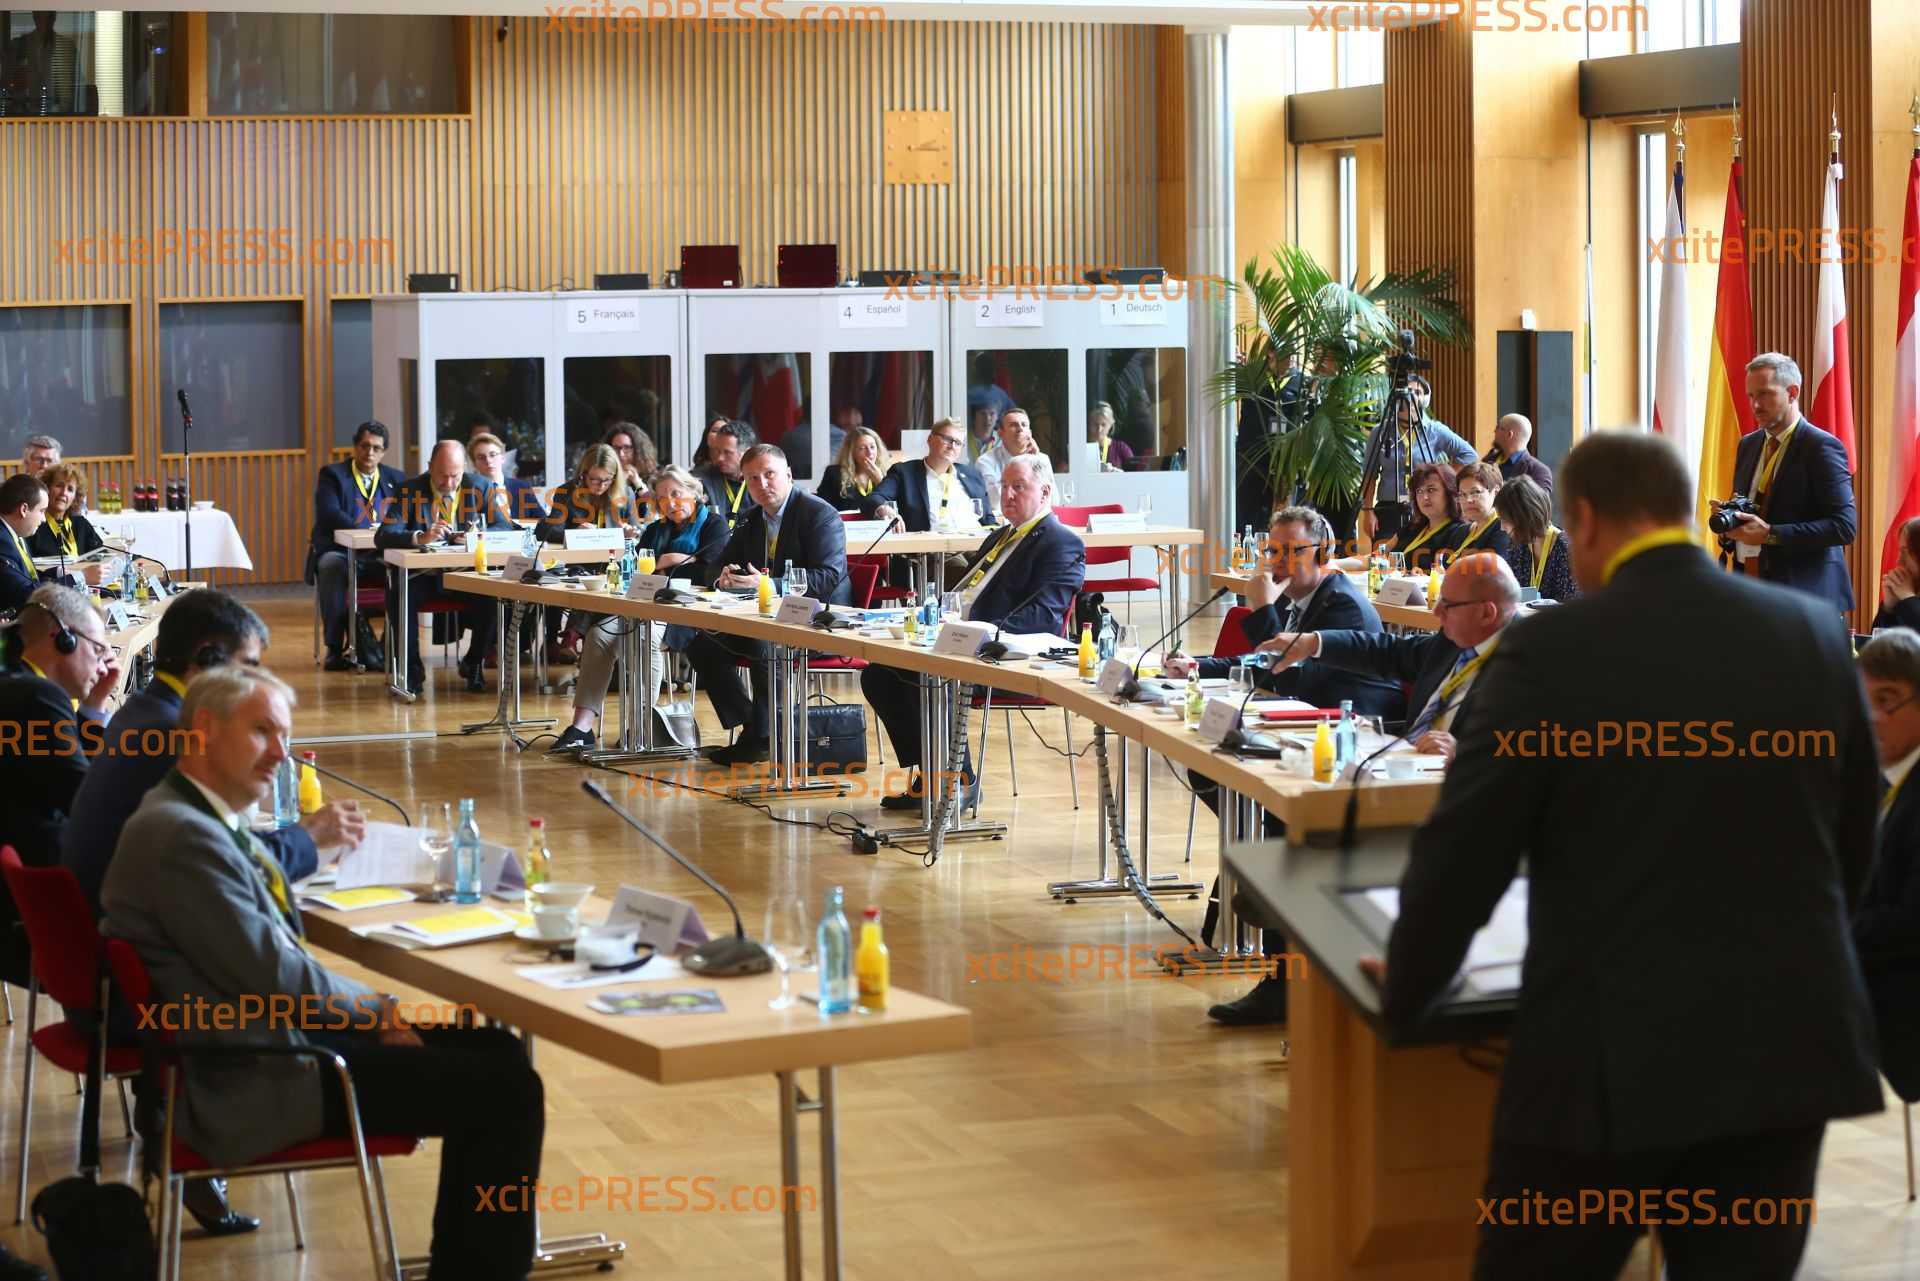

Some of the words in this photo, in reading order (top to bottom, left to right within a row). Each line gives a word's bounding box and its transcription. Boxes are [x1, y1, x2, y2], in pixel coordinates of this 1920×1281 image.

[843, 306, 852, 319] 4
[866, 304, 901, 316] Español
[981, 305, 990, 318] 2
[1005, 304, 1036, 315] English
[1111, 303, 1117, 316] 1
[1126, 302, 1162, 313] Deutsch
[577, 310, 587, 324] 5
[593, 309, 636, 320] Français
